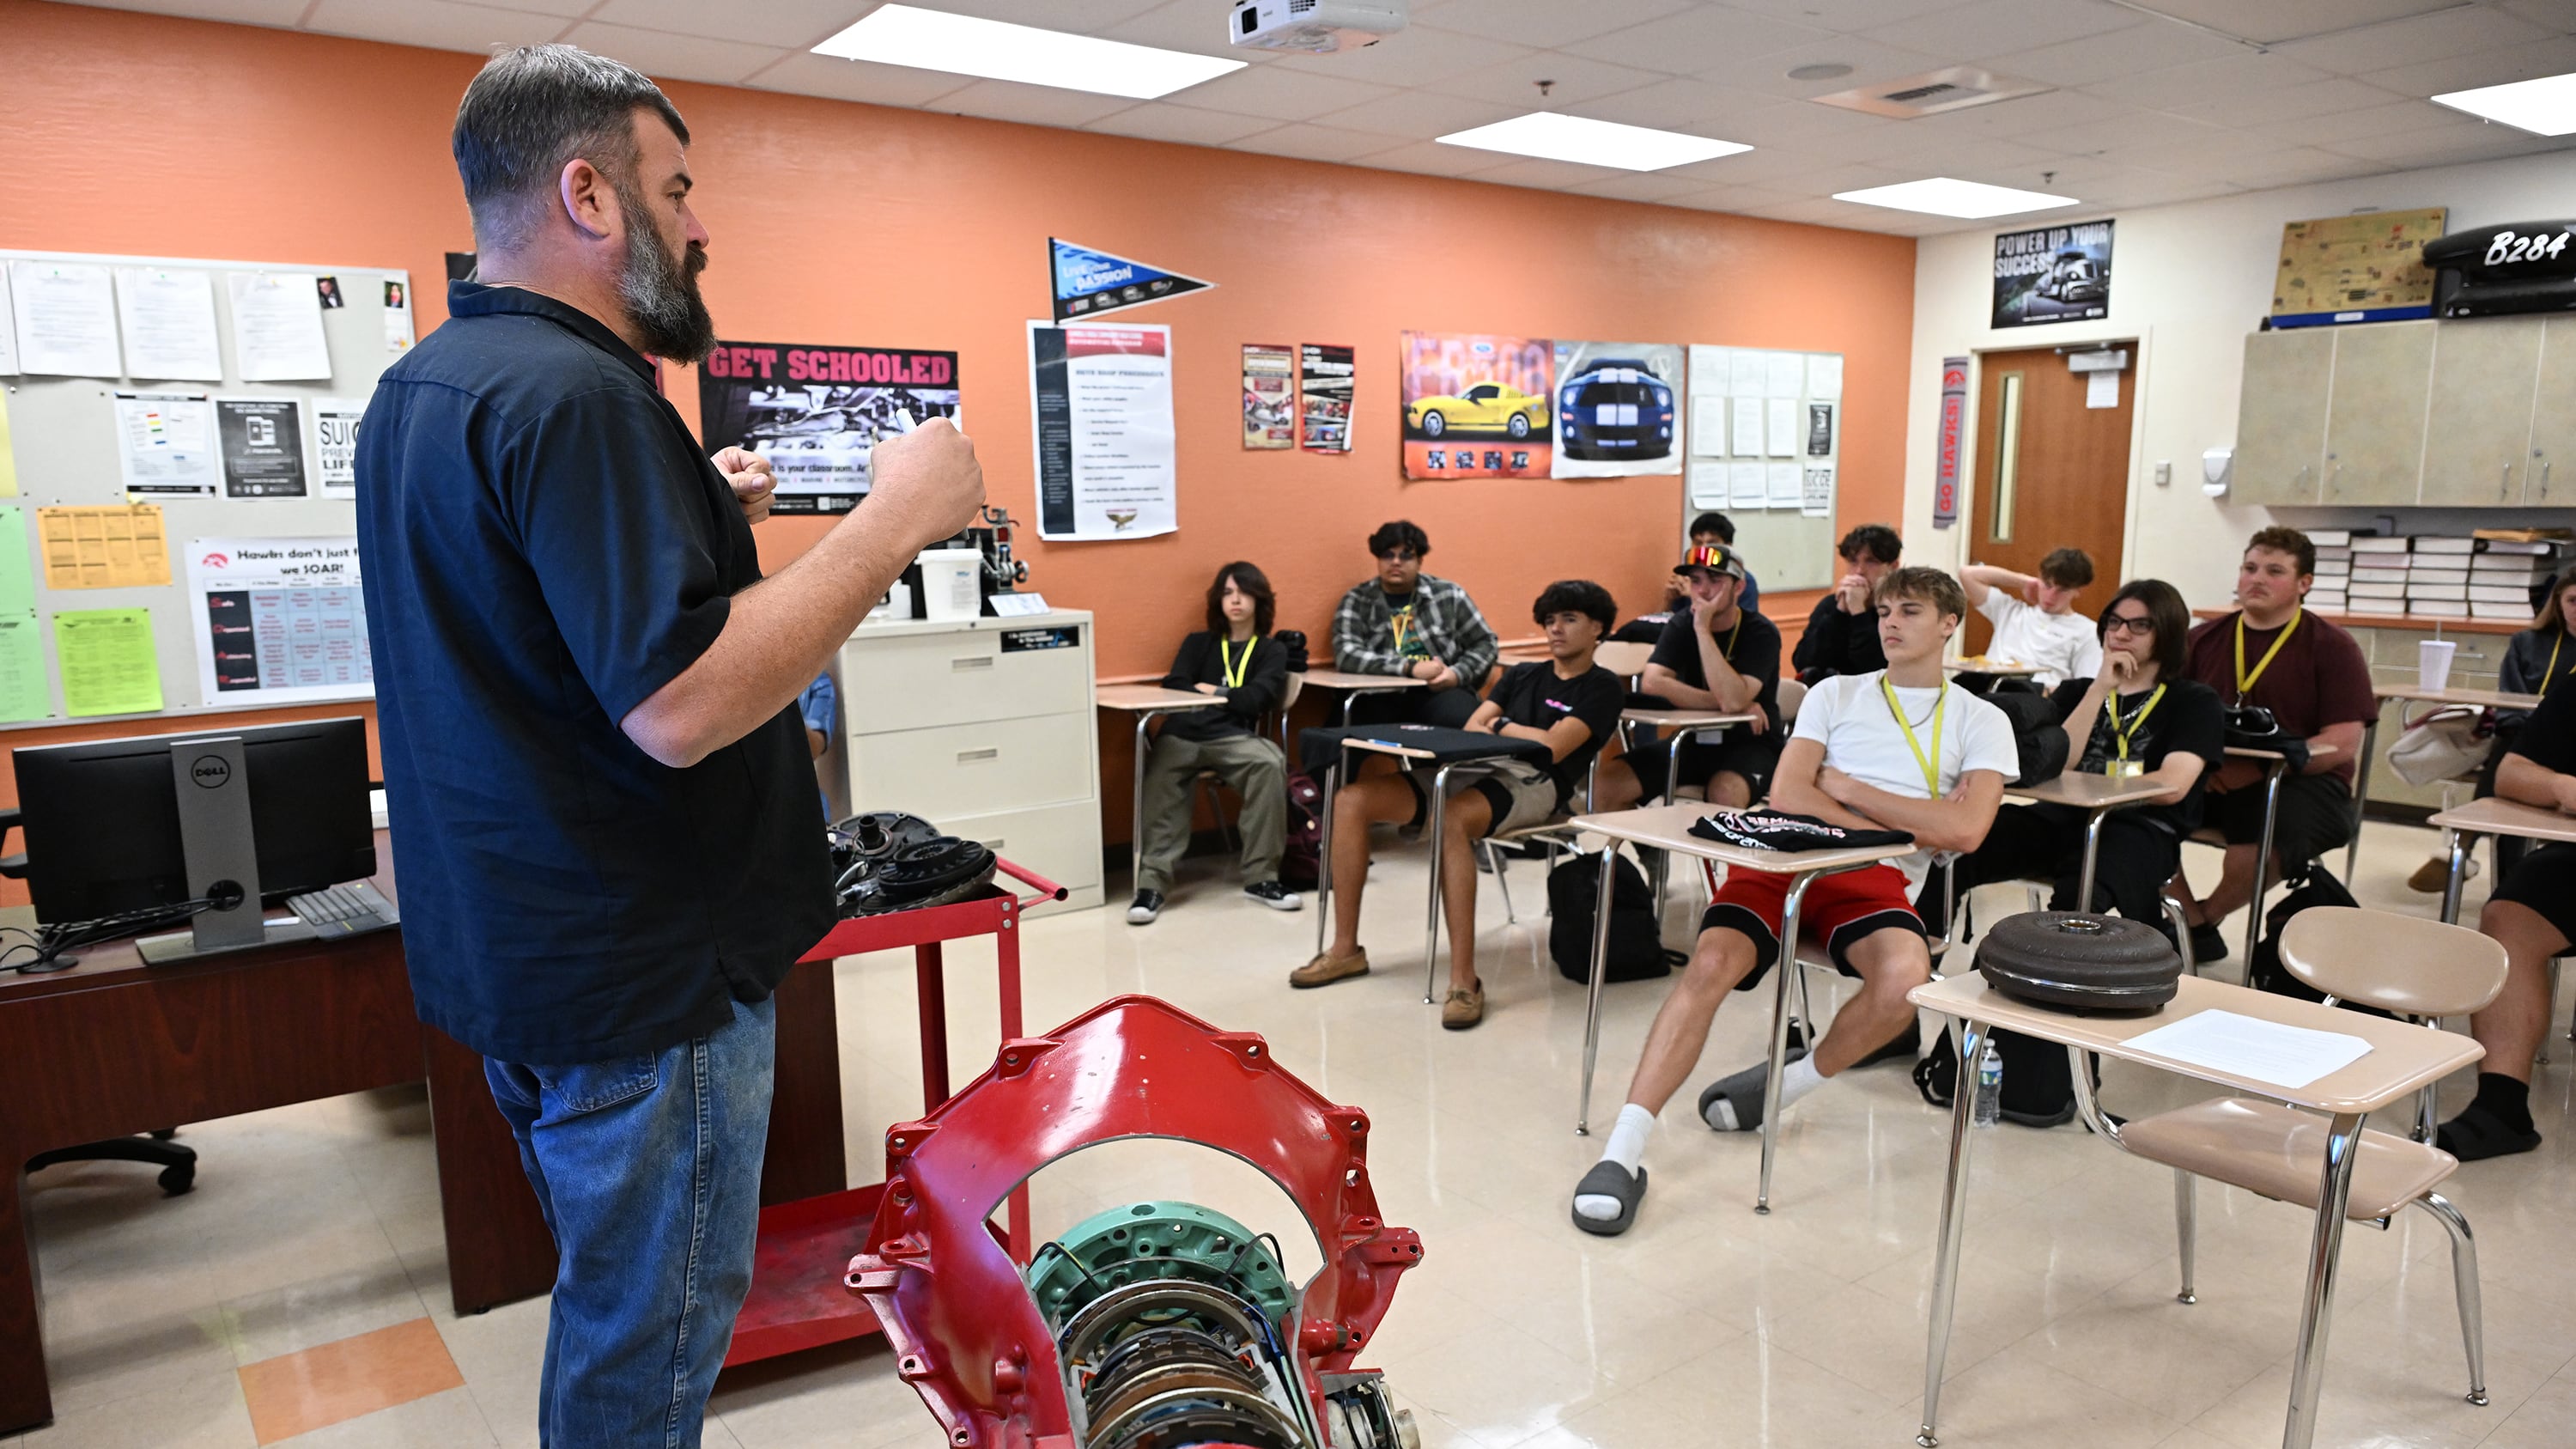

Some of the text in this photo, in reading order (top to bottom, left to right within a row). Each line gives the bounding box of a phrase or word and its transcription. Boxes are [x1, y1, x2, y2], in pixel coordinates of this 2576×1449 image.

[1997, 223, 2109, 256] POWER UP YOUR
[2484, 231, 2570, 266] B284
[1076, 265, 1133, 291] PASSION
[708, 346, 951, 384] GET SCHOOLED
[787, 465, 805, 474] your
[237, 550, 283, 559] Hawks
[288, 548, 322, 558] don't
[303, 563, 344, 574] SOAR!
[195, 766, 226, 777] DELL
